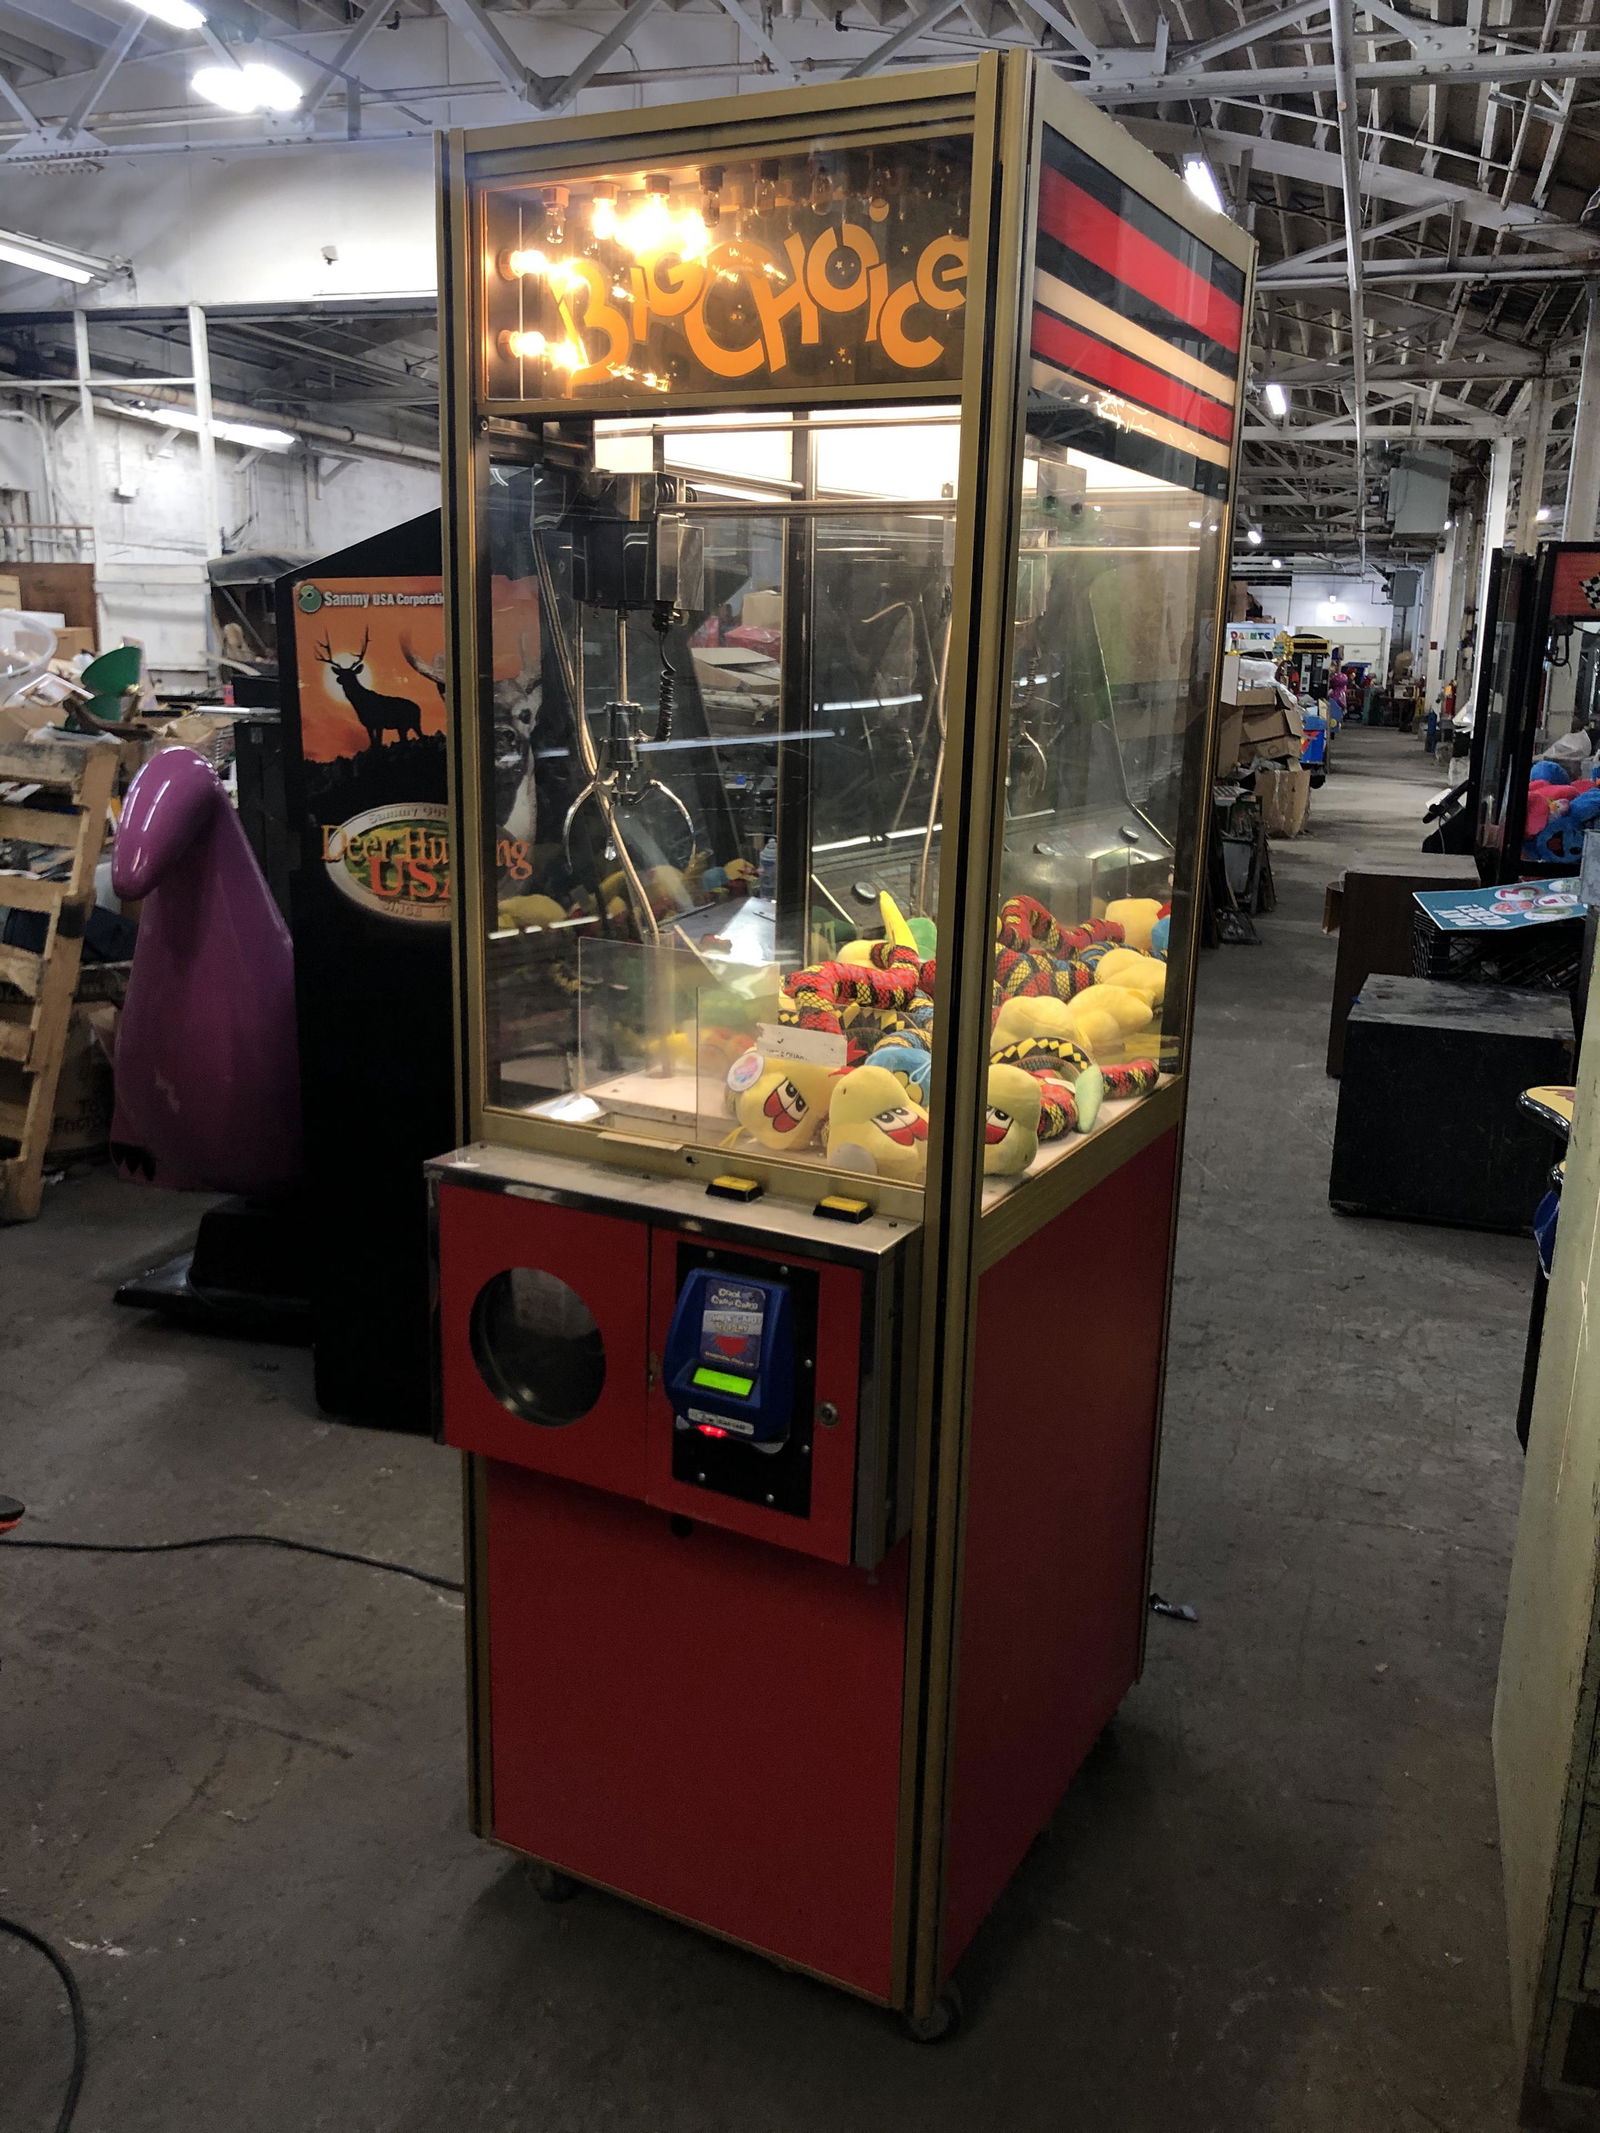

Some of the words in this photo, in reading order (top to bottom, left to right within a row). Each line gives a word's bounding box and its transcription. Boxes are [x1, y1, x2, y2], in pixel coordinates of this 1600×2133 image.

[323, 591, 370, 608] Sammy
[372, 593, 395, 606] USA
[396, 592, 444, 607] Corporati
[320, 825, 390, 862] Deer
[367, 856, 450, 899] US
